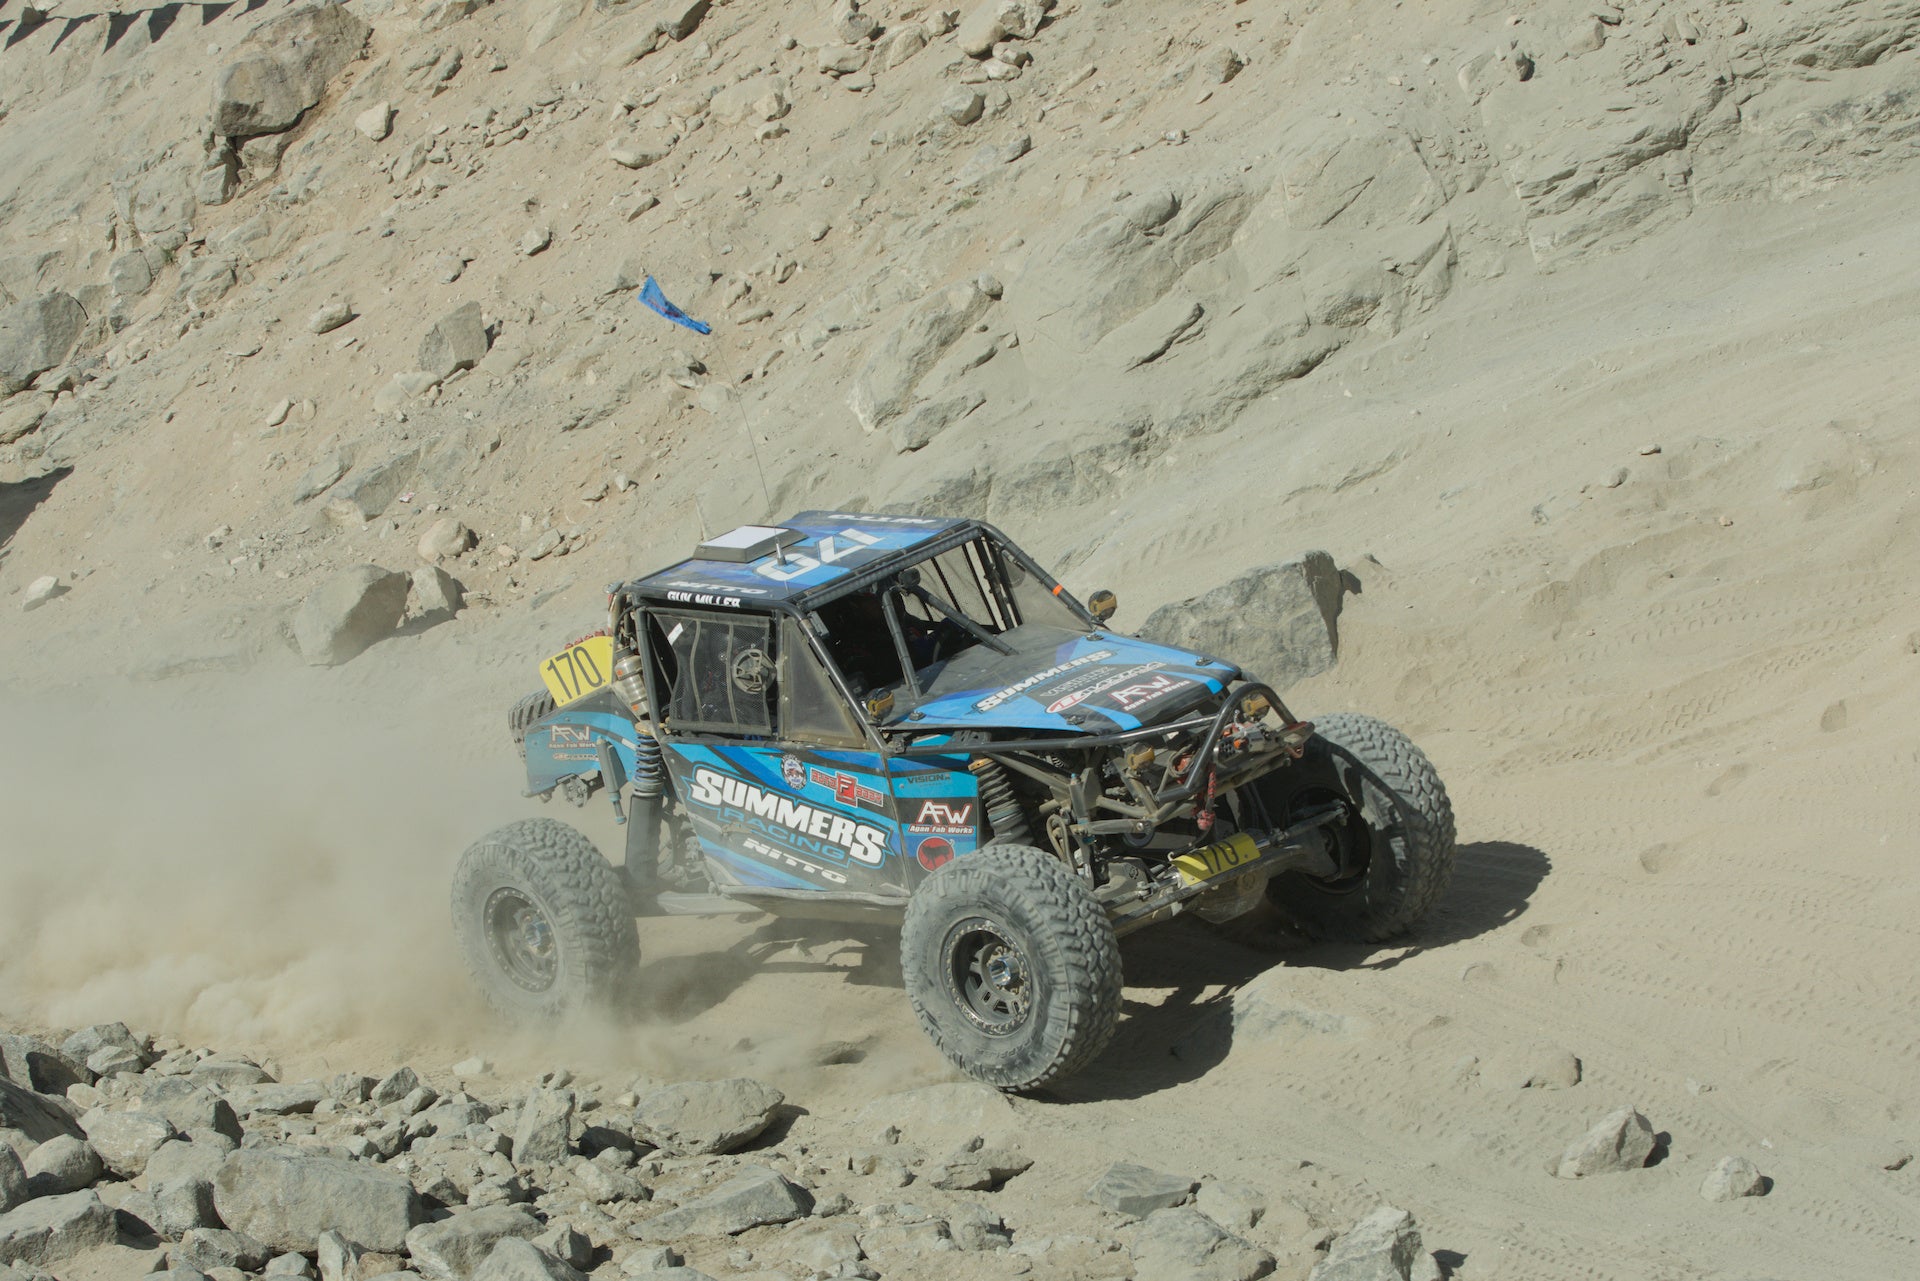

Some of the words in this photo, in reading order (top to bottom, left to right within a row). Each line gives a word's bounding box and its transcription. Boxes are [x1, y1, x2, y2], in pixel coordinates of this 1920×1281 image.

[695, 594, 741, 608] MILLER
[546, 646, 602, 700] 170
[976, 650, 1113, 713] SUMMERS
[907, 774, 944, 784] VISION
[690, 768, 886, 864] SUMMERS
[723, 806, 846, 859] RACING
[909, 825, 930, 833] Agan
[917, 801, 971, 824] AFW
[742, 837, 849, 885] NITTO
